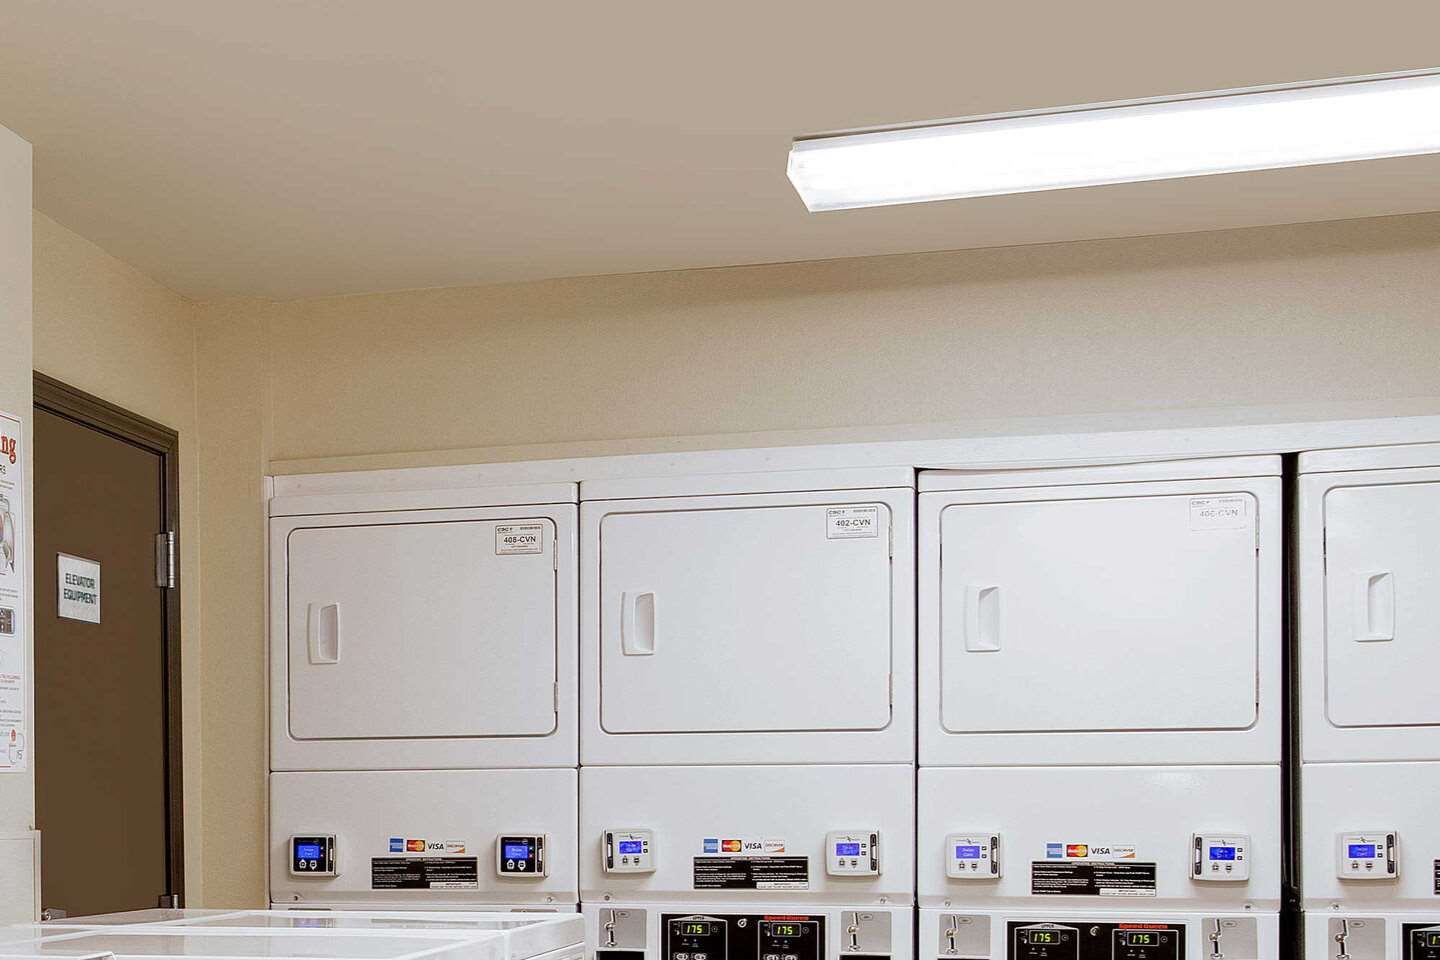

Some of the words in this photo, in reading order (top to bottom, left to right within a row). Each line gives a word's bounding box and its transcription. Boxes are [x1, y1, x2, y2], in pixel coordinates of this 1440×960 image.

[66, 573, 95, 589] ELEVATOR
[64, 588, 97, 605] EQUIPMENT
[687, 925, 702, 933] 175
[778, 926, 792, 934] 175
[1034, 933, 1051, 942] 175
[1133, 935, 1150, 943] 175
